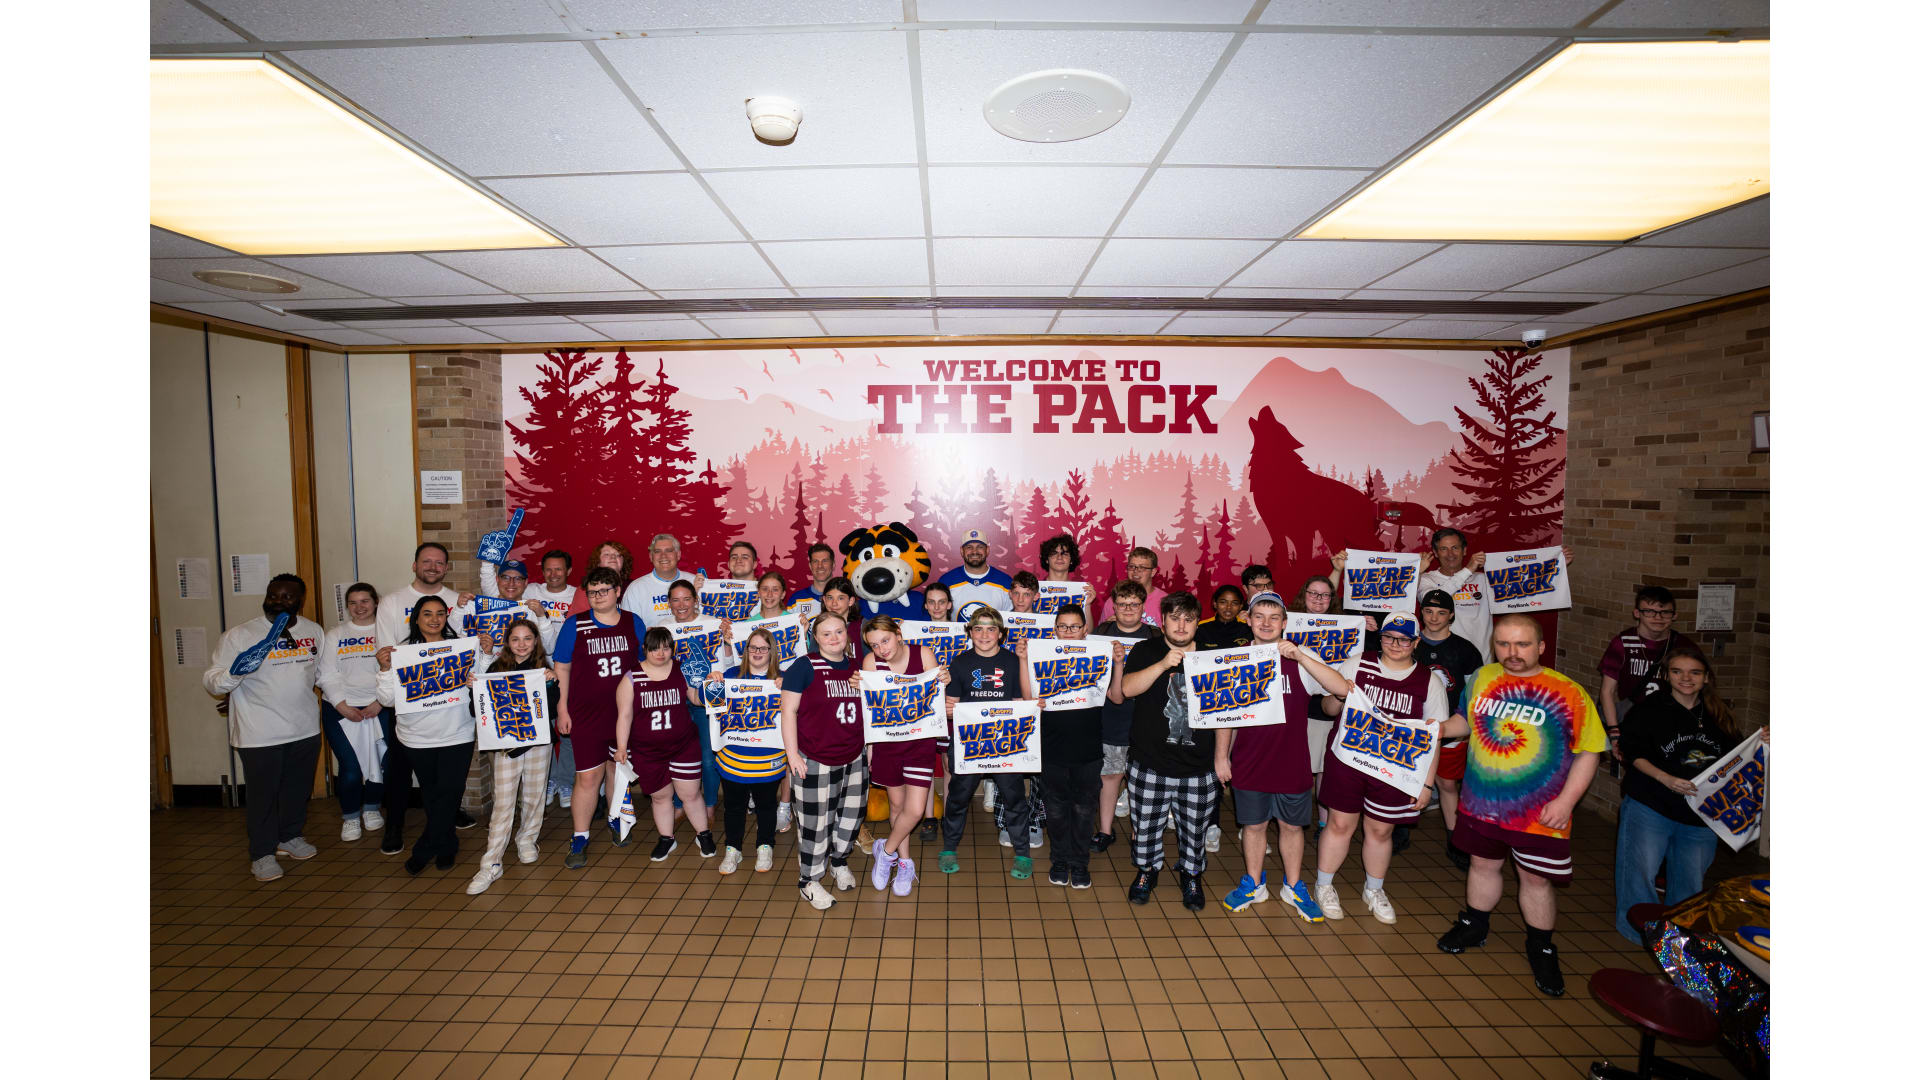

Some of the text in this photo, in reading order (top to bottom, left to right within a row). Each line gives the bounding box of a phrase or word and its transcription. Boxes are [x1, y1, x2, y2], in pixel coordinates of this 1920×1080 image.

[923, 360, 1161, 382] WELCOME TO
[867, 384, 1218, 434] THE PACK
[1347, 566, 1416, 585] WE'RE
[1486, 558, 1559, 587] WE'RE
[701, 591, 761, 609] WE'RE
[1350, 580, 1407, 601] BACK
[1493, 574, 1555, 603] BACK
[541, 601, 571, 611] OCKEY
[702, 604, 755, 623] BACK
[338, 637, 377, 648] HOCK
[586, 635, 628, 655] TONAWANDA
[1286, 628, 1360, 648] WE'RE
[268, 647, 309, 659] ASSISTS
[397, 649, 476, 687] WE'RE
[597, 656, 622, 678] 32
[1033, 655, 1109, 683] WE'RE
[1191, 659, 1276, 697] WE'RE
[405, 667, 471, 702] BACK
[824, 679, 861, 698] TONAW
[864, 678, 939, 709] WE'RE
[1038, 673, 1100, 699] BACK
[1199, 680, 1271, 714] BACK
[422, 700, 447, 708] KeyBank
[487, 679, 519, 739] BACK
[505, 673, 537, 741] WE'RE
[640, 688, 681, 708] TONAWANDA
[1363, 683, 1413, 715] TONAWANDA
[651, 709, 672, 731] 21
[719, 710, 777, 736] BACK
[836, 702, 857, 724] 43
[870, 699, 936, 728] BACK
[1216, 715, 1242, 723] KeyBank
[1473, 696, 1546, 727] UNIFIED
[727, 735, 750, 743] KeyBank
[958, 715, 1037, 744] WE'RE
[1343, 707, 1432, 754] WE'RE
[963, 733, 1028, 761] BACK
[1340, 727, 1417, 771] BACK
[1352, 756, 1380, 772] KeyBank
